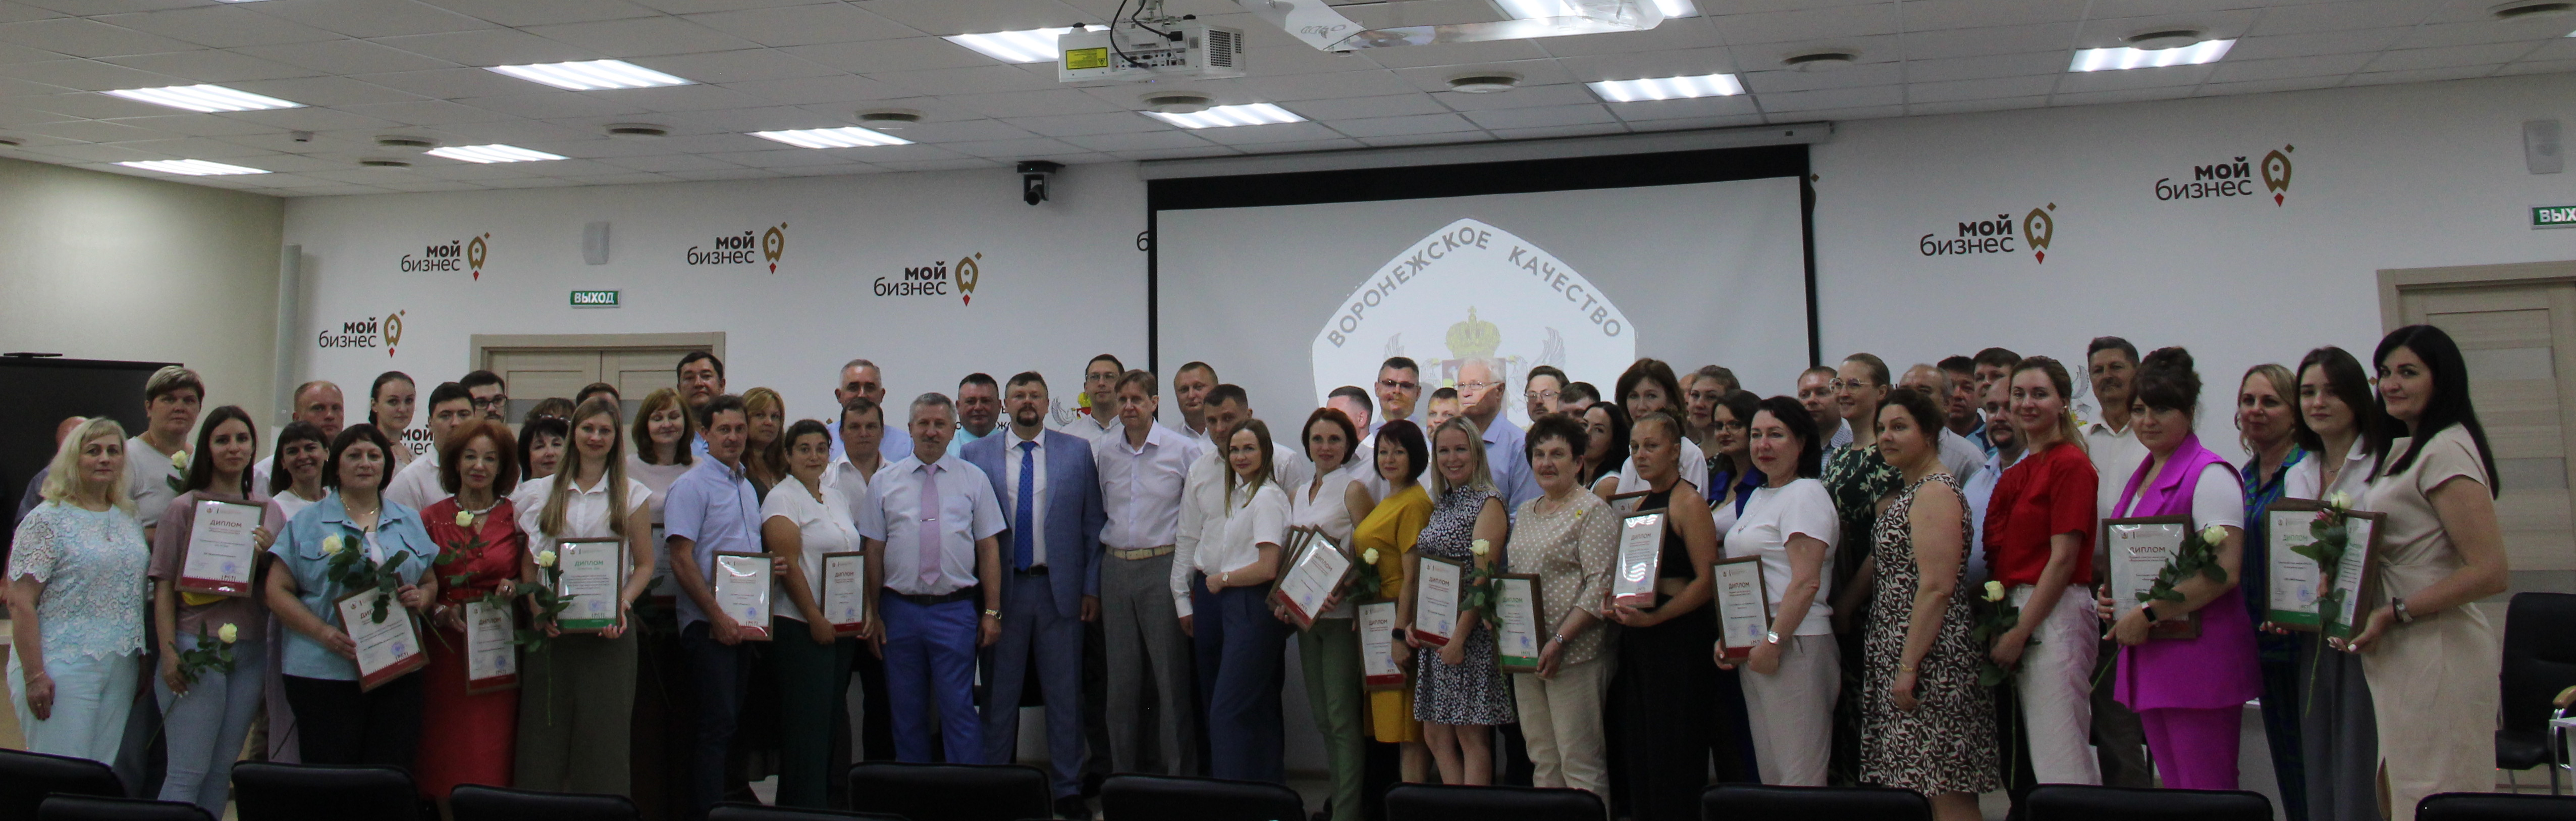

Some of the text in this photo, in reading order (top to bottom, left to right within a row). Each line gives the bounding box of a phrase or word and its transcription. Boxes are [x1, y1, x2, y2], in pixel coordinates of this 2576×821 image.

[2156, 178, 2252, 200] бизнес
[1920, 233, 2014, 256] бизнес
[401, 255, 460, 272] бизнес
[687, 246, 754, 265] бизнес
[874, 277, 947, 296] бизнес
[1327, 227, 1621, 348] ВОРОНЕЖСКОЕ КАЧЕСТВО
[574, 292, 614, 304] ВЫХОД
[319, 331, 377, 348] бизнес
[210, 520, 242, 528] ДИПЛОМ
[1429, 577, 1450, 586] ДИПЛОМ
[1729, 582, 1750, 590] ДИПЛОМ
